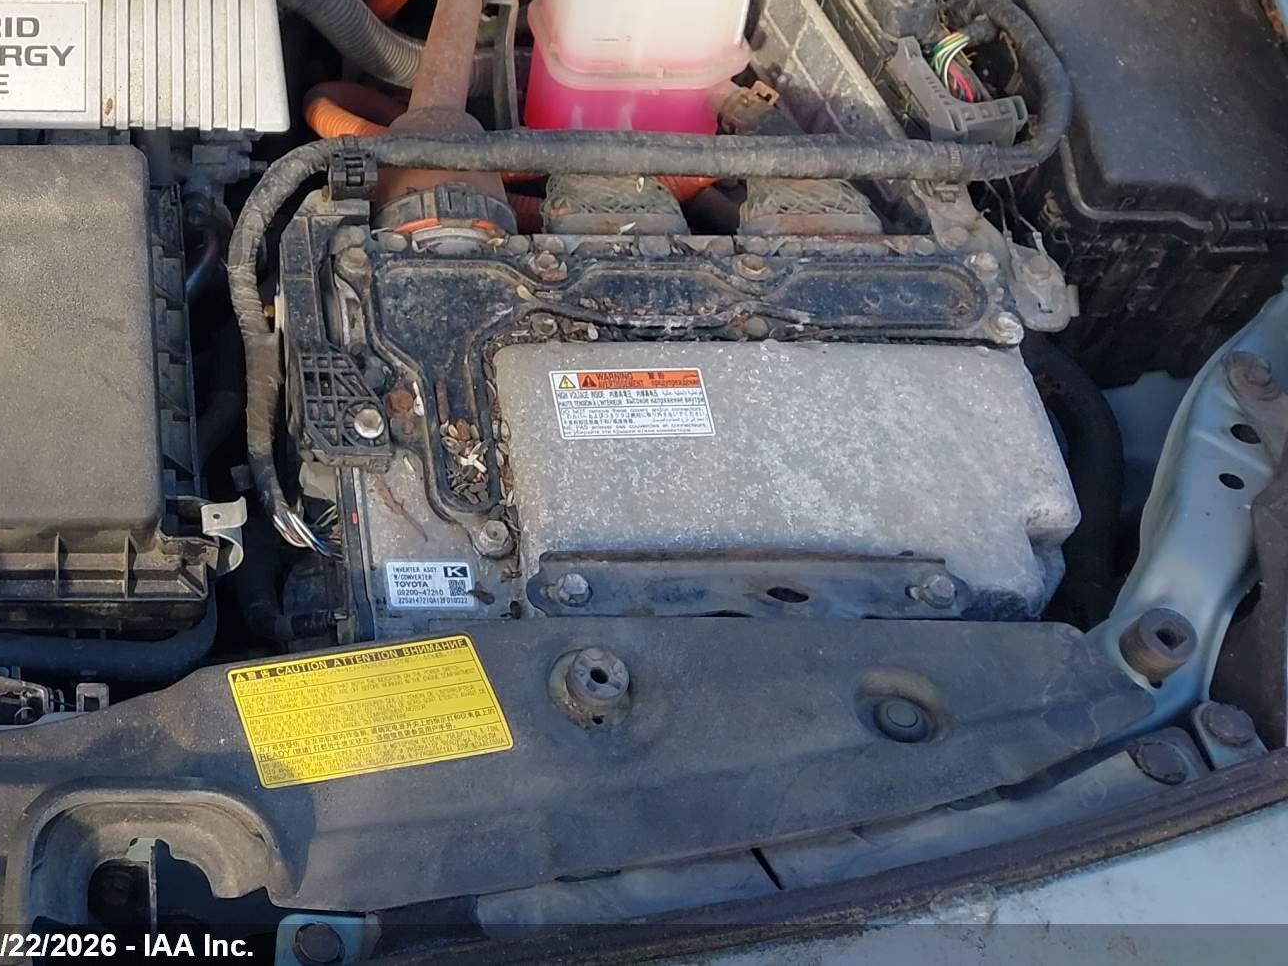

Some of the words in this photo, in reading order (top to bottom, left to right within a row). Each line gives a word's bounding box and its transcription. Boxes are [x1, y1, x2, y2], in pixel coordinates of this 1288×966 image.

[596, 372, 633, 381] WARNING
[275, 661, 328, 676] CAUTION
[333, 650, 399, 667] ATTENTION
[402, 639, 466, 656] ВНИМАНИЕ
[258, 749, 291, 761] READY
